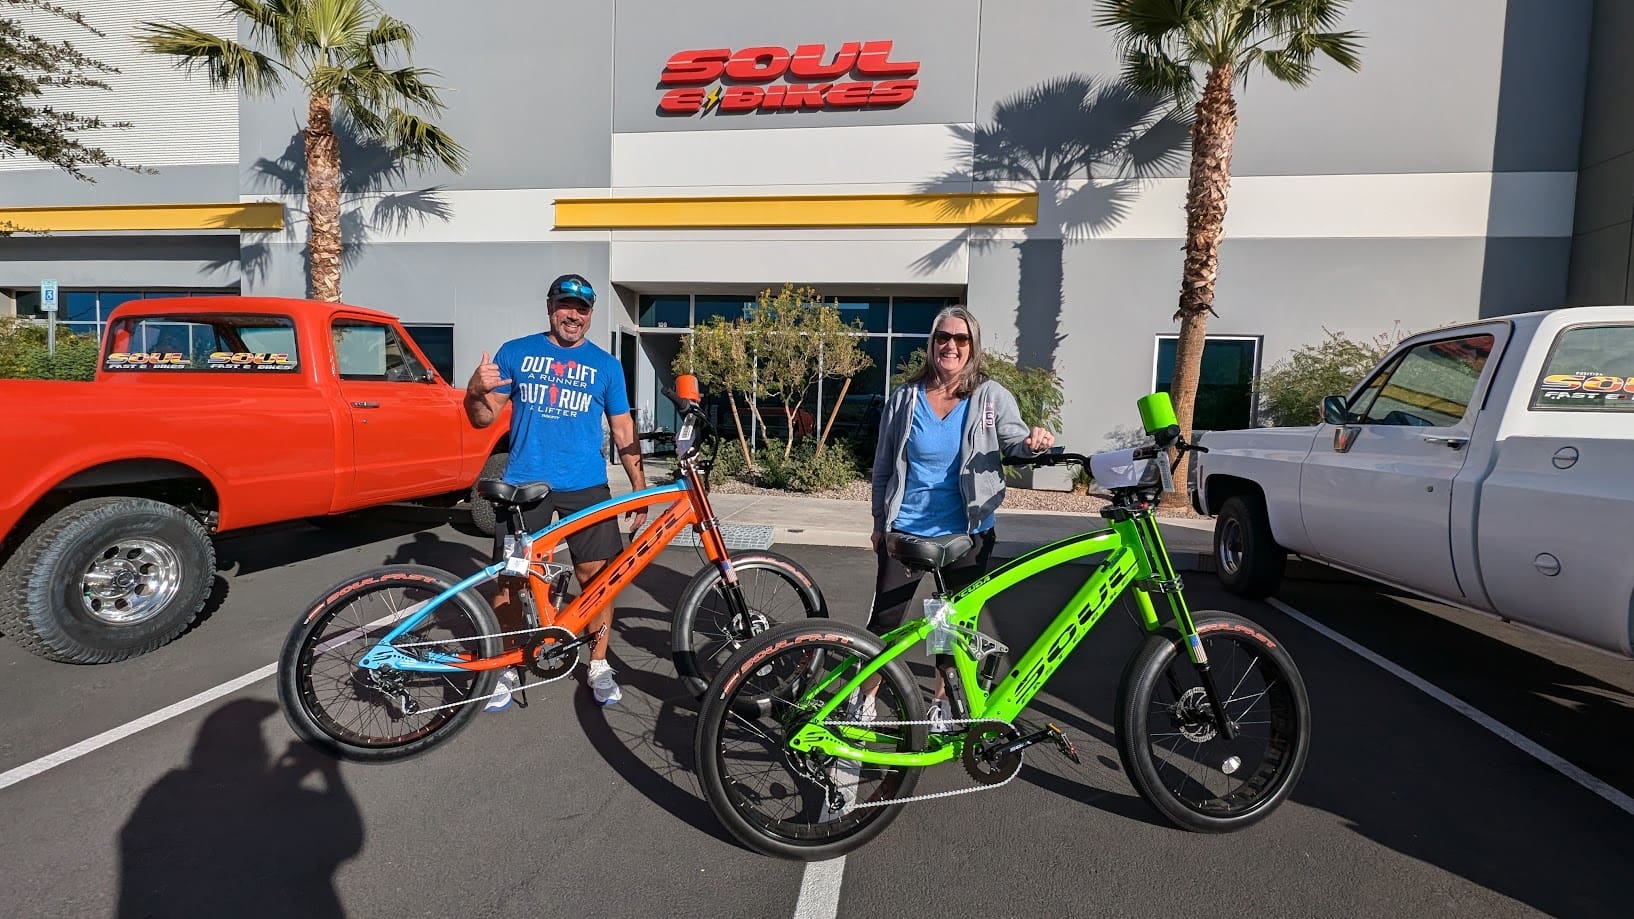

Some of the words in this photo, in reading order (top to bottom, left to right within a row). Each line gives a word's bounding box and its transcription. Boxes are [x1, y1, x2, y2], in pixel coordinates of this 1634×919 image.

[660, 40, 921, 84] SOUL
[720, 79, 920, 111] BIKES
[106, 352, 191, 365] SOUL
[207, 351, 298, 365] SOUL
[520, 355, 554, 375] OUT
[568, 363, 598, 385] LIFT
[540, 373, 588, 389] RUNNER
[1540, 374, 1634, 393] SO
[1544, 391, 1601, 400] FAST
[519, 382, 549, 405] OUT
[558, 388, 593, 413] RUN
[537, 405, 578, 418] LIFTER
[577, 506, 692, 618] SOUL
[326, 577, 380, 605] SOUL
[1013, 558, 1140, 705] SOUL
[740, 639, 795, 674] SOUL
